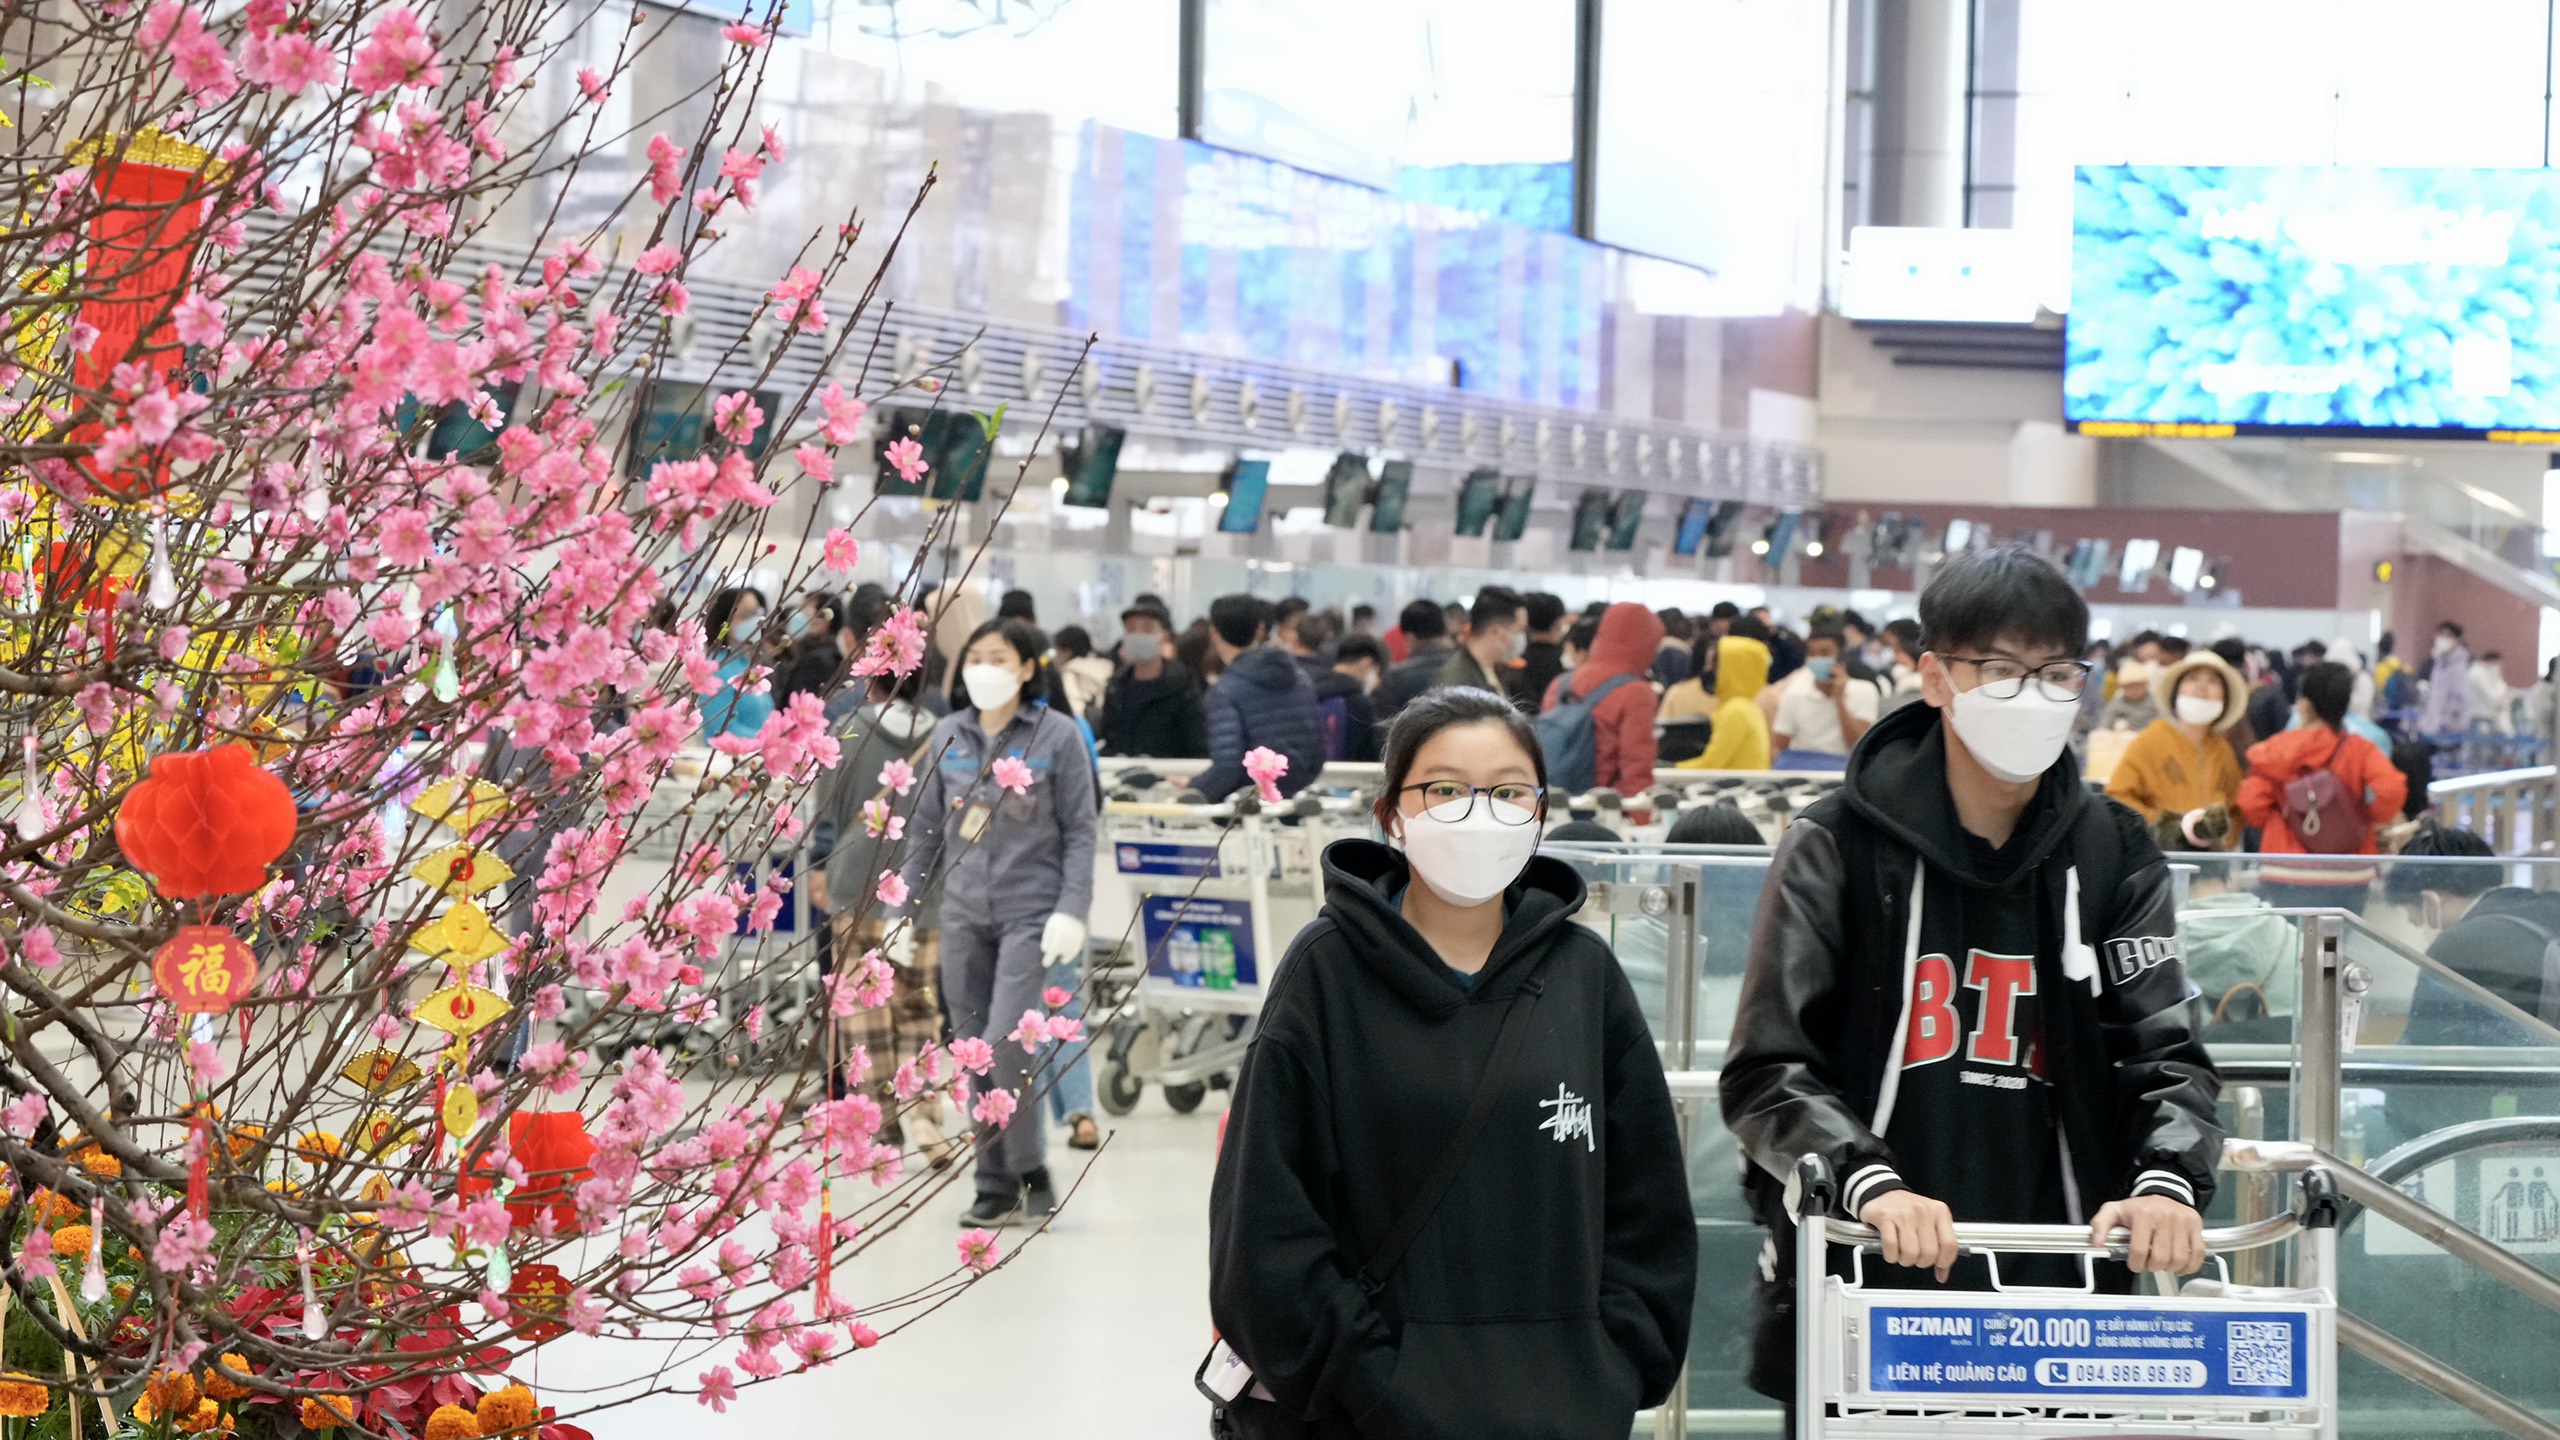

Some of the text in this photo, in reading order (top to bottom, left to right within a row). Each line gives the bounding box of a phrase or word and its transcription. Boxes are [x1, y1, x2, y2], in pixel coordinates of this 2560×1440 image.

[177, 943, 231, 996] 福
[1900, 948, 2047, 1081] BT
[1887, 1317, 1972, 1336] BIZMAN
[2009, 1317, 2091, 1347] 20.000
[1888, 1360, 2027, 1384] LIÊN HỆ QUẢNG CÁO
